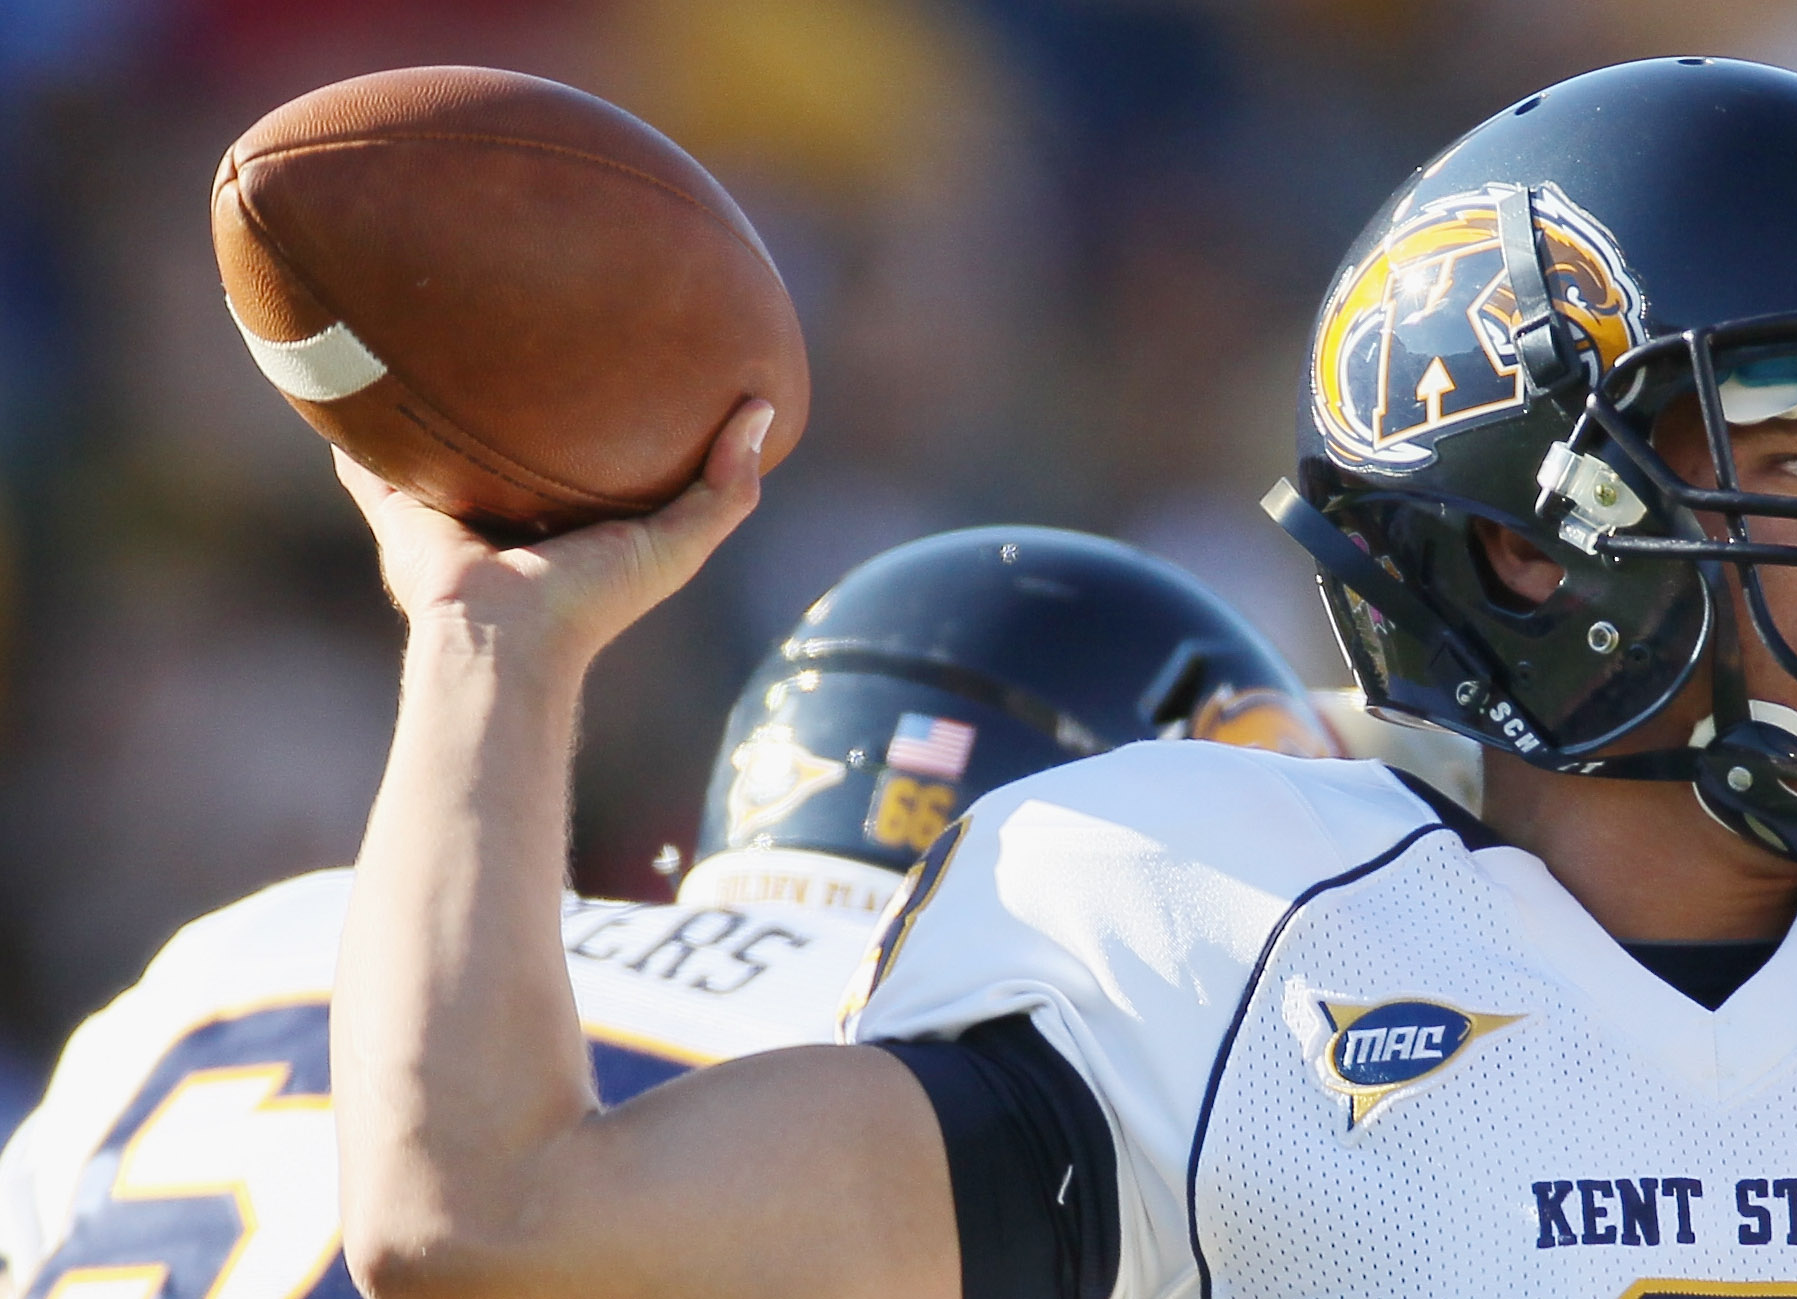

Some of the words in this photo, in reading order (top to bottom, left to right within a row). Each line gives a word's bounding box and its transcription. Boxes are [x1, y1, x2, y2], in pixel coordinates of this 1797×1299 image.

[563, 899, 812, 994] ERS
[1343, 1025, 1447, 1068] MAC
[1531, 1177, 1704, 1250] KENT
